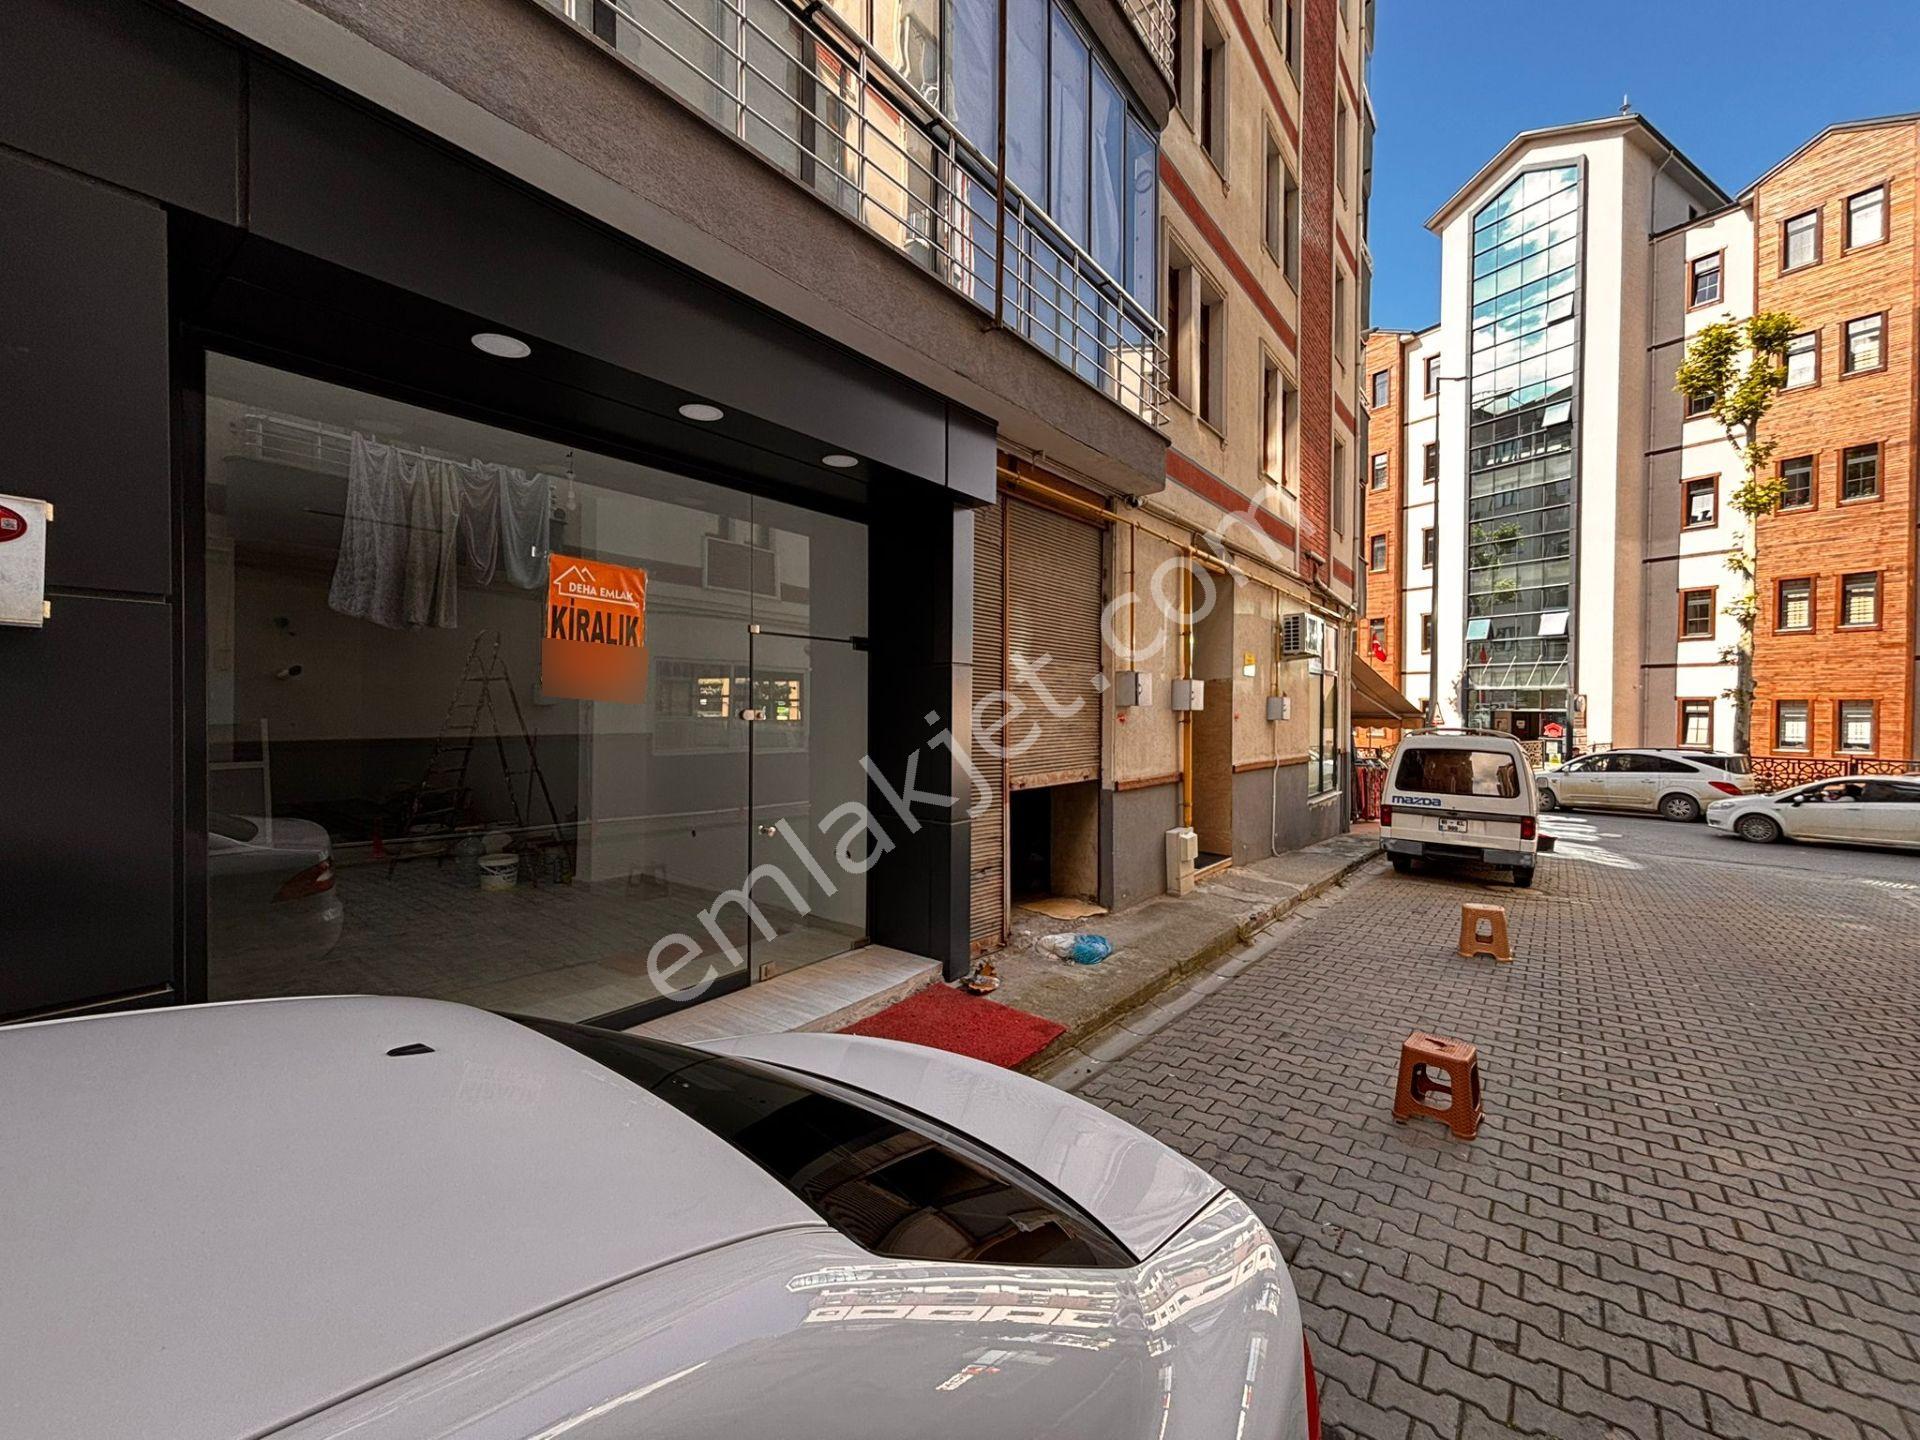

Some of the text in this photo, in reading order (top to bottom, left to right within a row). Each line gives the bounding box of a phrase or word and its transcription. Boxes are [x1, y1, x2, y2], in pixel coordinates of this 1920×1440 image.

[569, 582, 634, 602] DEHA EMLAK
[551, 598, 640, 647] KİRALIK
